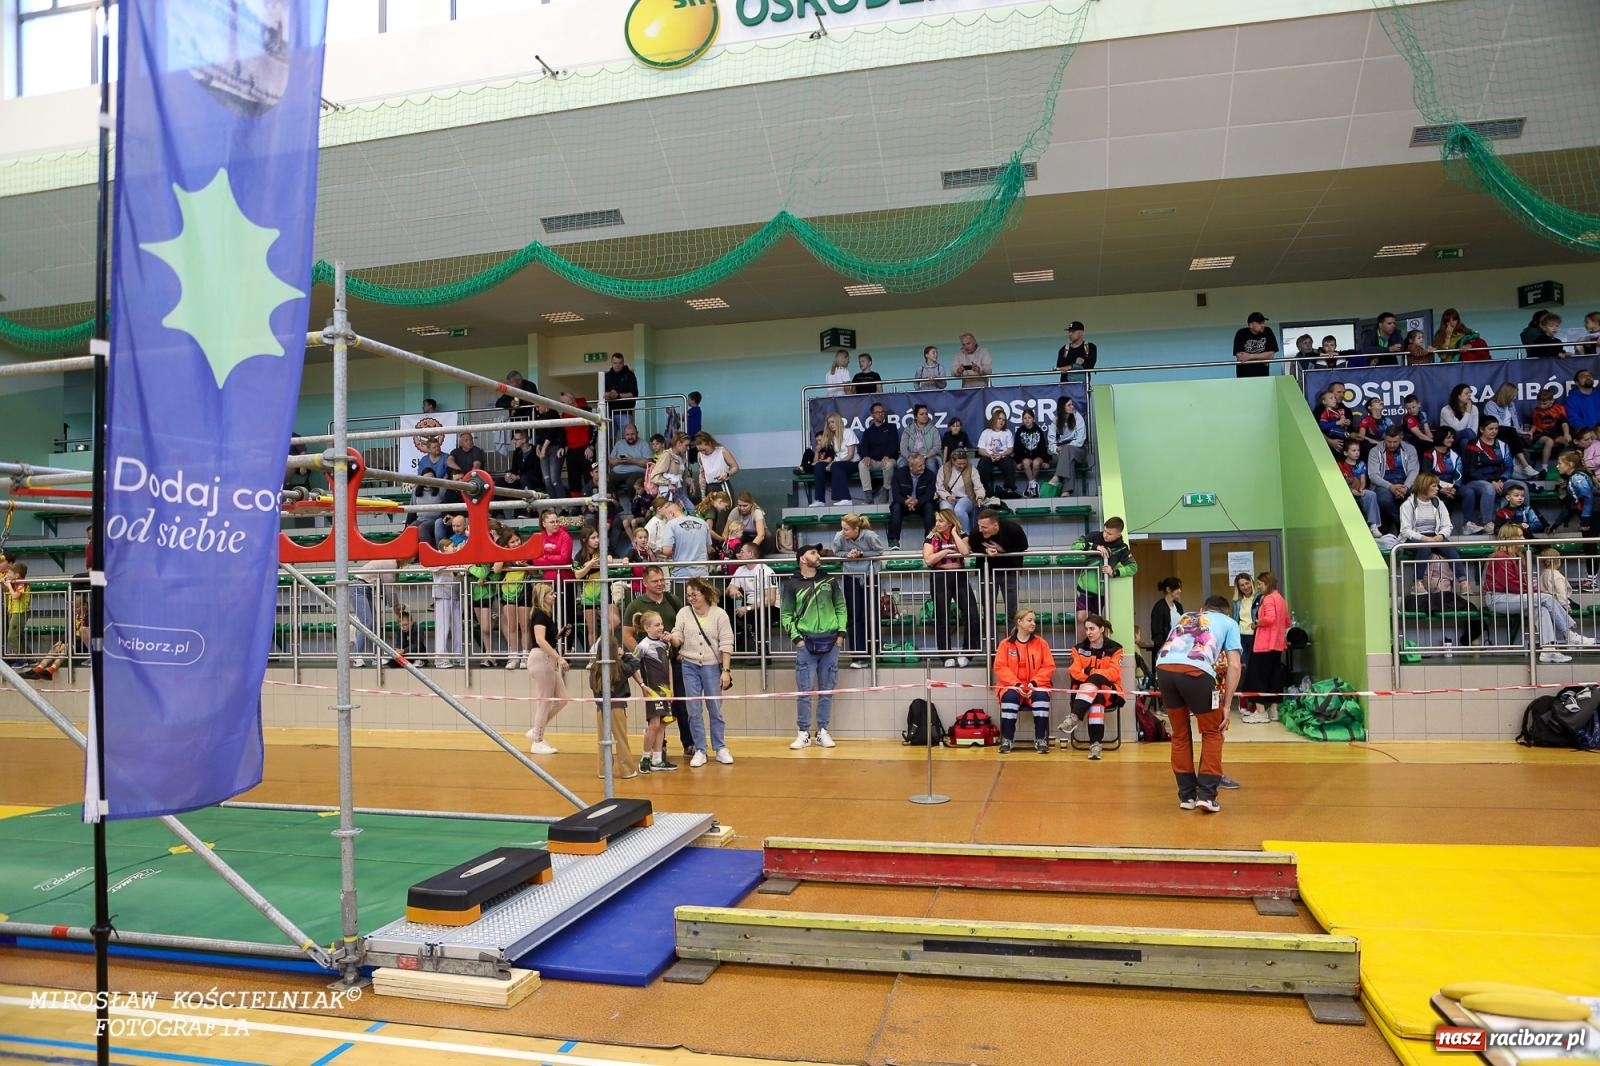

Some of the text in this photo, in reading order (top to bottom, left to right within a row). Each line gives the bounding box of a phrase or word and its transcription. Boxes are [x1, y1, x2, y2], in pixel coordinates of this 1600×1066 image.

[1527, 290, 1542, 304] F
[839, 334, 851, 347] E
[113, 456, 221, 517] Dodaj
[107, 508, 247, 554] od siebie
